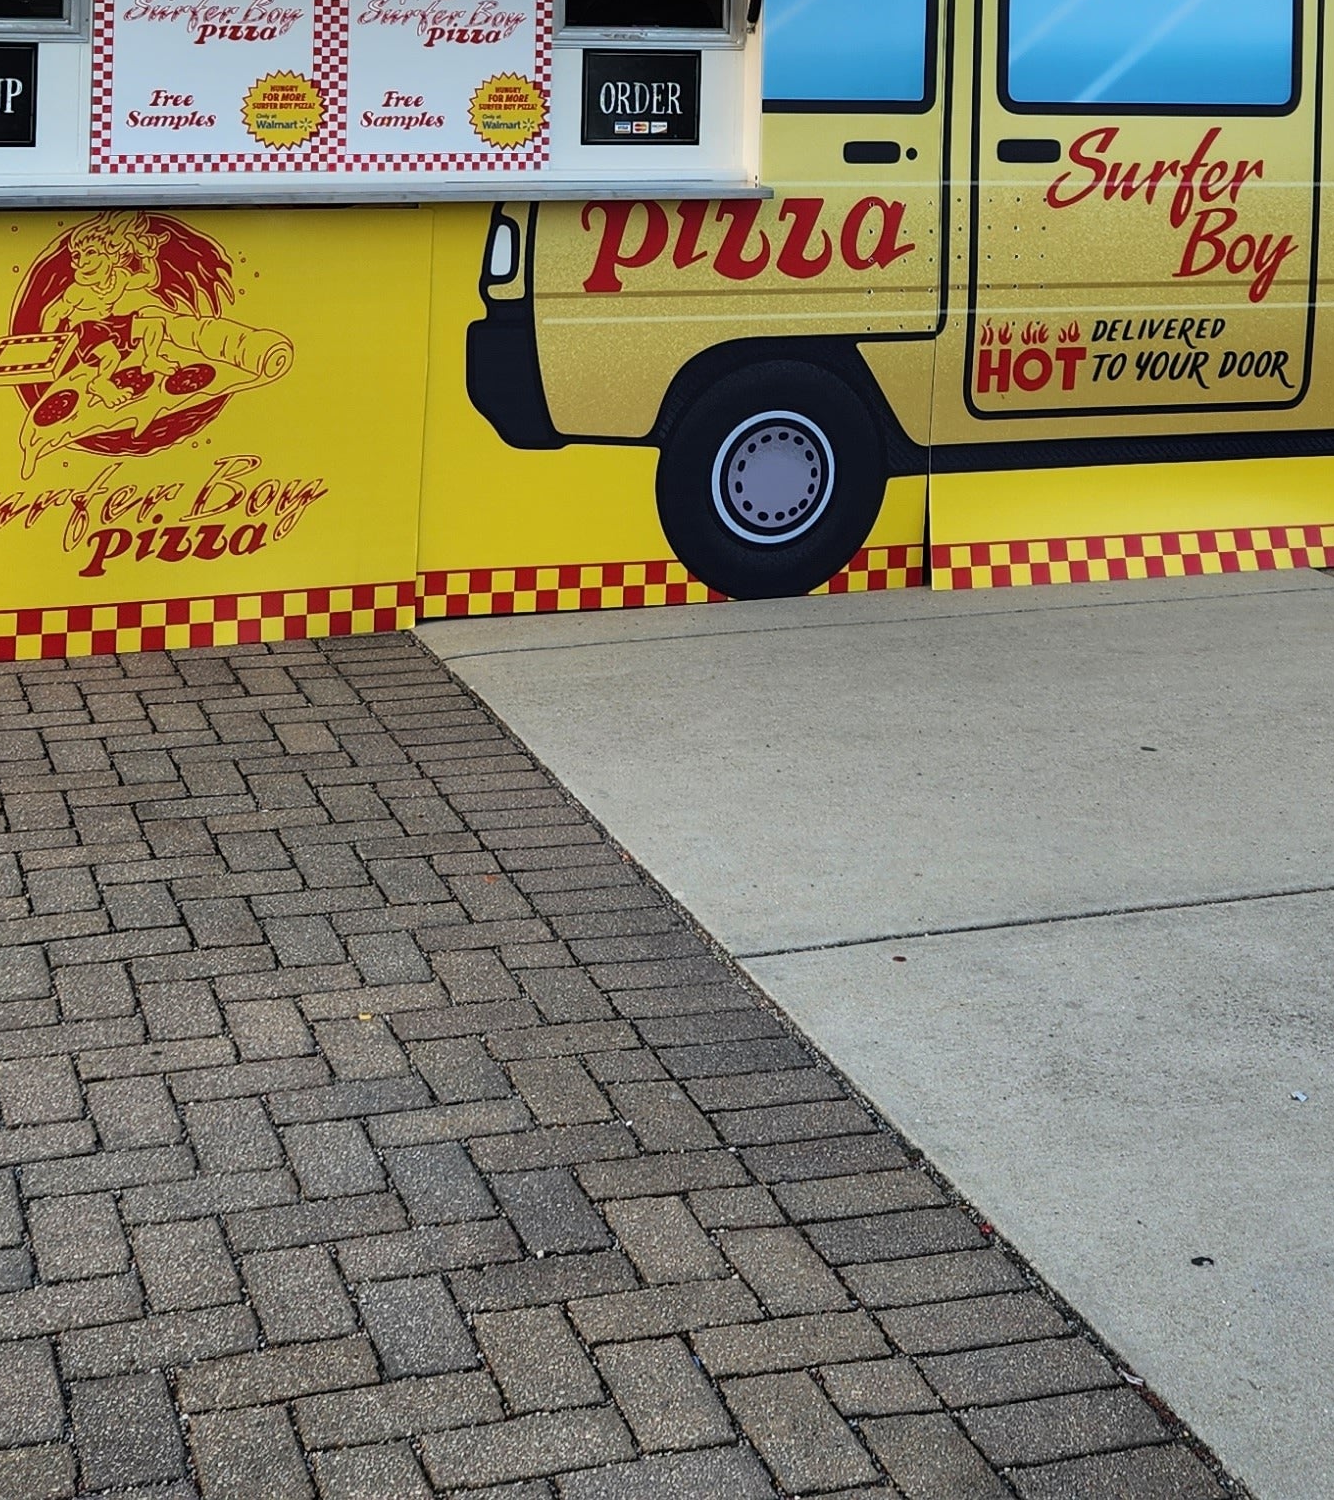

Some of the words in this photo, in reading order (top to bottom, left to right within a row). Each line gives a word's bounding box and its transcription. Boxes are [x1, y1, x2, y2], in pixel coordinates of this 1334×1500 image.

[464, 0, 528, 39] Boy
[149, 89, 195, 107] Free
[262, 93, 279, 101] FOR
[281, 93, 307, 101] MORE
[381, 90, 425, 108] Free
[488, 94, 504, 102] FOR
[505, 94, 530, 102] MORE
[599, 81, 684, 115] ORDER
[126, 110, 217, 130] Samples
[255, 120, 298, 129] Walmart
[360, 111, 445, 130] Samples
[482, 121, 521, 130] Walmart
[1046, 127, 1264, 229] Surfer
[1172, 207, 1299, 303] Boy
[1091, 317, 1226, 349] DELIVERED
[977, 347, 1087, 393] HOT
[1092, 352, 1127, 382] TO
[1135, 351, 1210, 389] YOUR
[1218, 350, 1295, 388] DOOR
[178, 455, 329, 541] Boy
